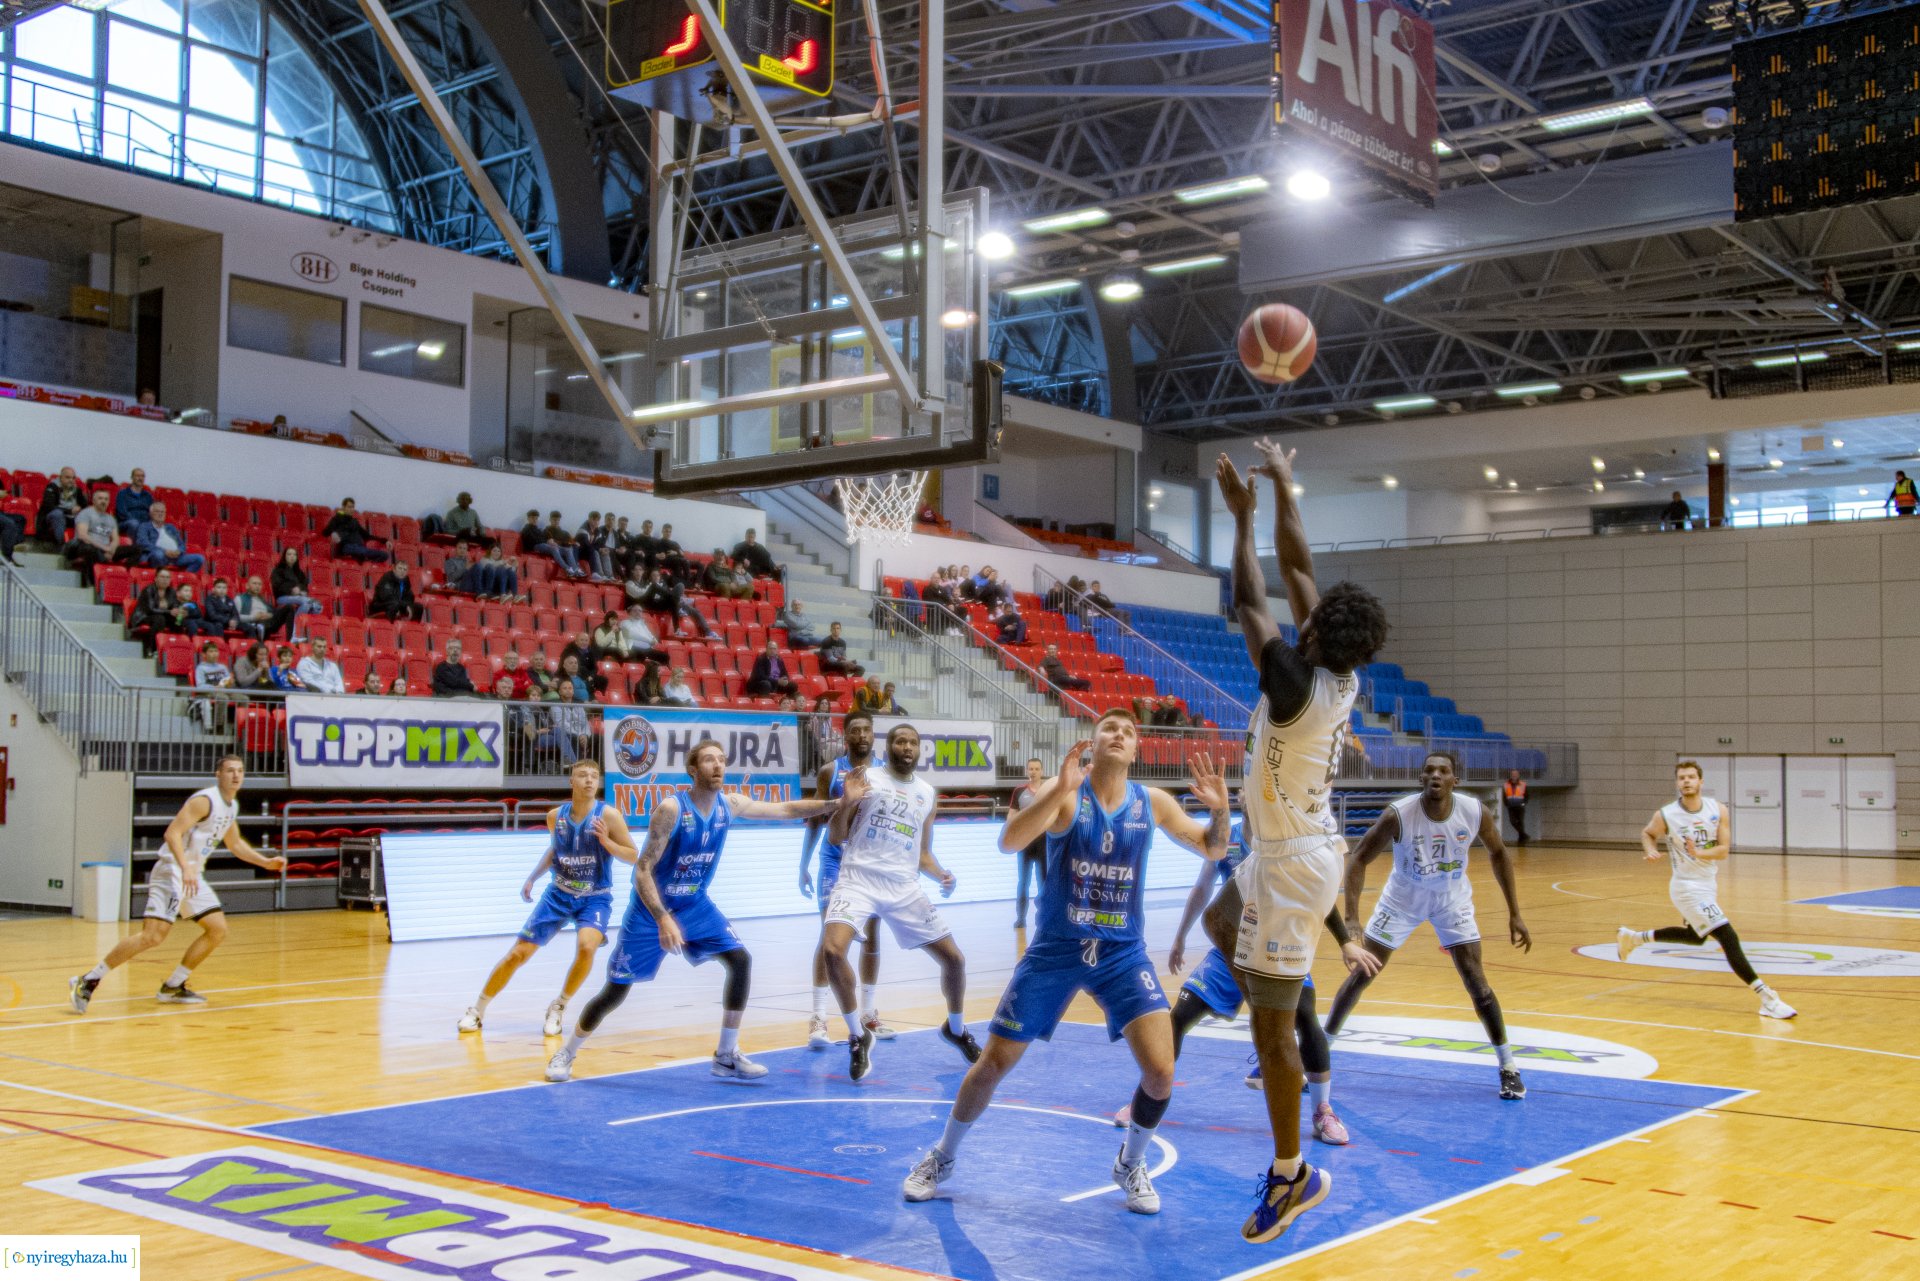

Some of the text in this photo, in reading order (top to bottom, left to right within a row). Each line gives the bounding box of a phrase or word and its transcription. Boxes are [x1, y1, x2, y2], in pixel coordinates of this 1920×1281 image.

[1291, 98, 1318, 125] Ahol
[1320, 116, 1328, 131] a
[1330, 120, 1362, 148] pénze
[1364, 135, 1399, 166] többet
[300, 256, 331, 279] BH
[350, 262, 417, 288] Bige Holding
[362, 280, 404, 297] Csoport
[667, 722, 785, 768] HJRÁ
[891, 799, 908, 818] 22
[1102, 831, 1114, 854] 8
[1694, 829, 1708, 842] 20
[1431, 844, 1445, 859] 21
[1072, 859, 1133, 880] KOMETA
[831, 900, 851, 912] 22
[1703, 904, 1720, 918] 20
[1373, 911, 1391, 929] 21
[1141, 971, 1155, 990] 8
